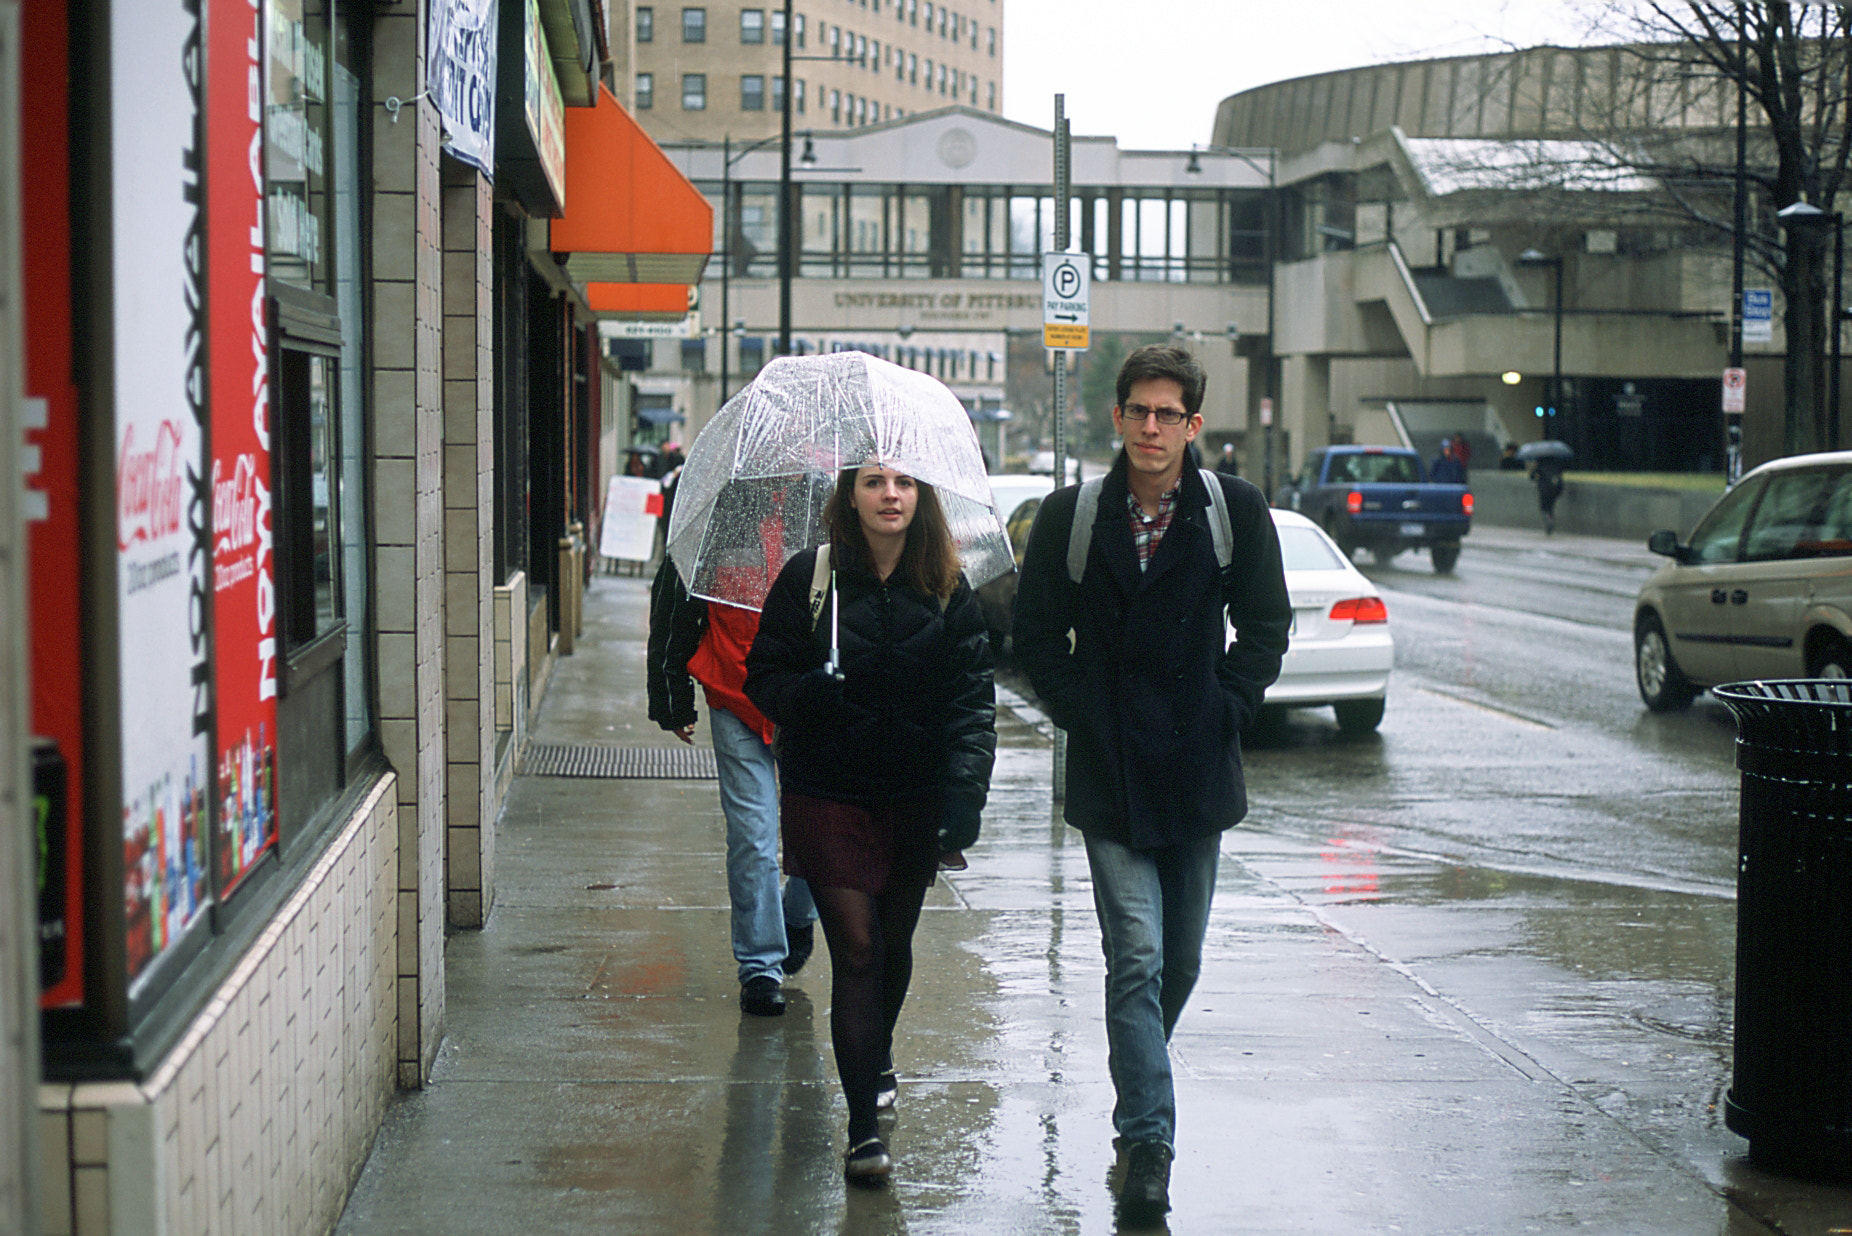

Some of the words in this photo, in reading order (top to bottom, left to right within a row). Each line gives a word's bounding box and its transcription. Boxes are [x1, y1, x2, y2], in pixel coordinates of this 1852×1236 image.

[247, 0, 272, 451] AVAILABL
[1062, 270, 1074, 291] P
[834, 293, 934, 308] UNIVERSITY
[941, 293, 961, 308] OF
[968, 293, 1043, 309] PITTSBU
[1047, 301, 1058, 311] PAY
[1060, 302, 1086, 312] PARKING
[186, 459, 208, 738] NOW
[255, 475, 277, 700] NOW
